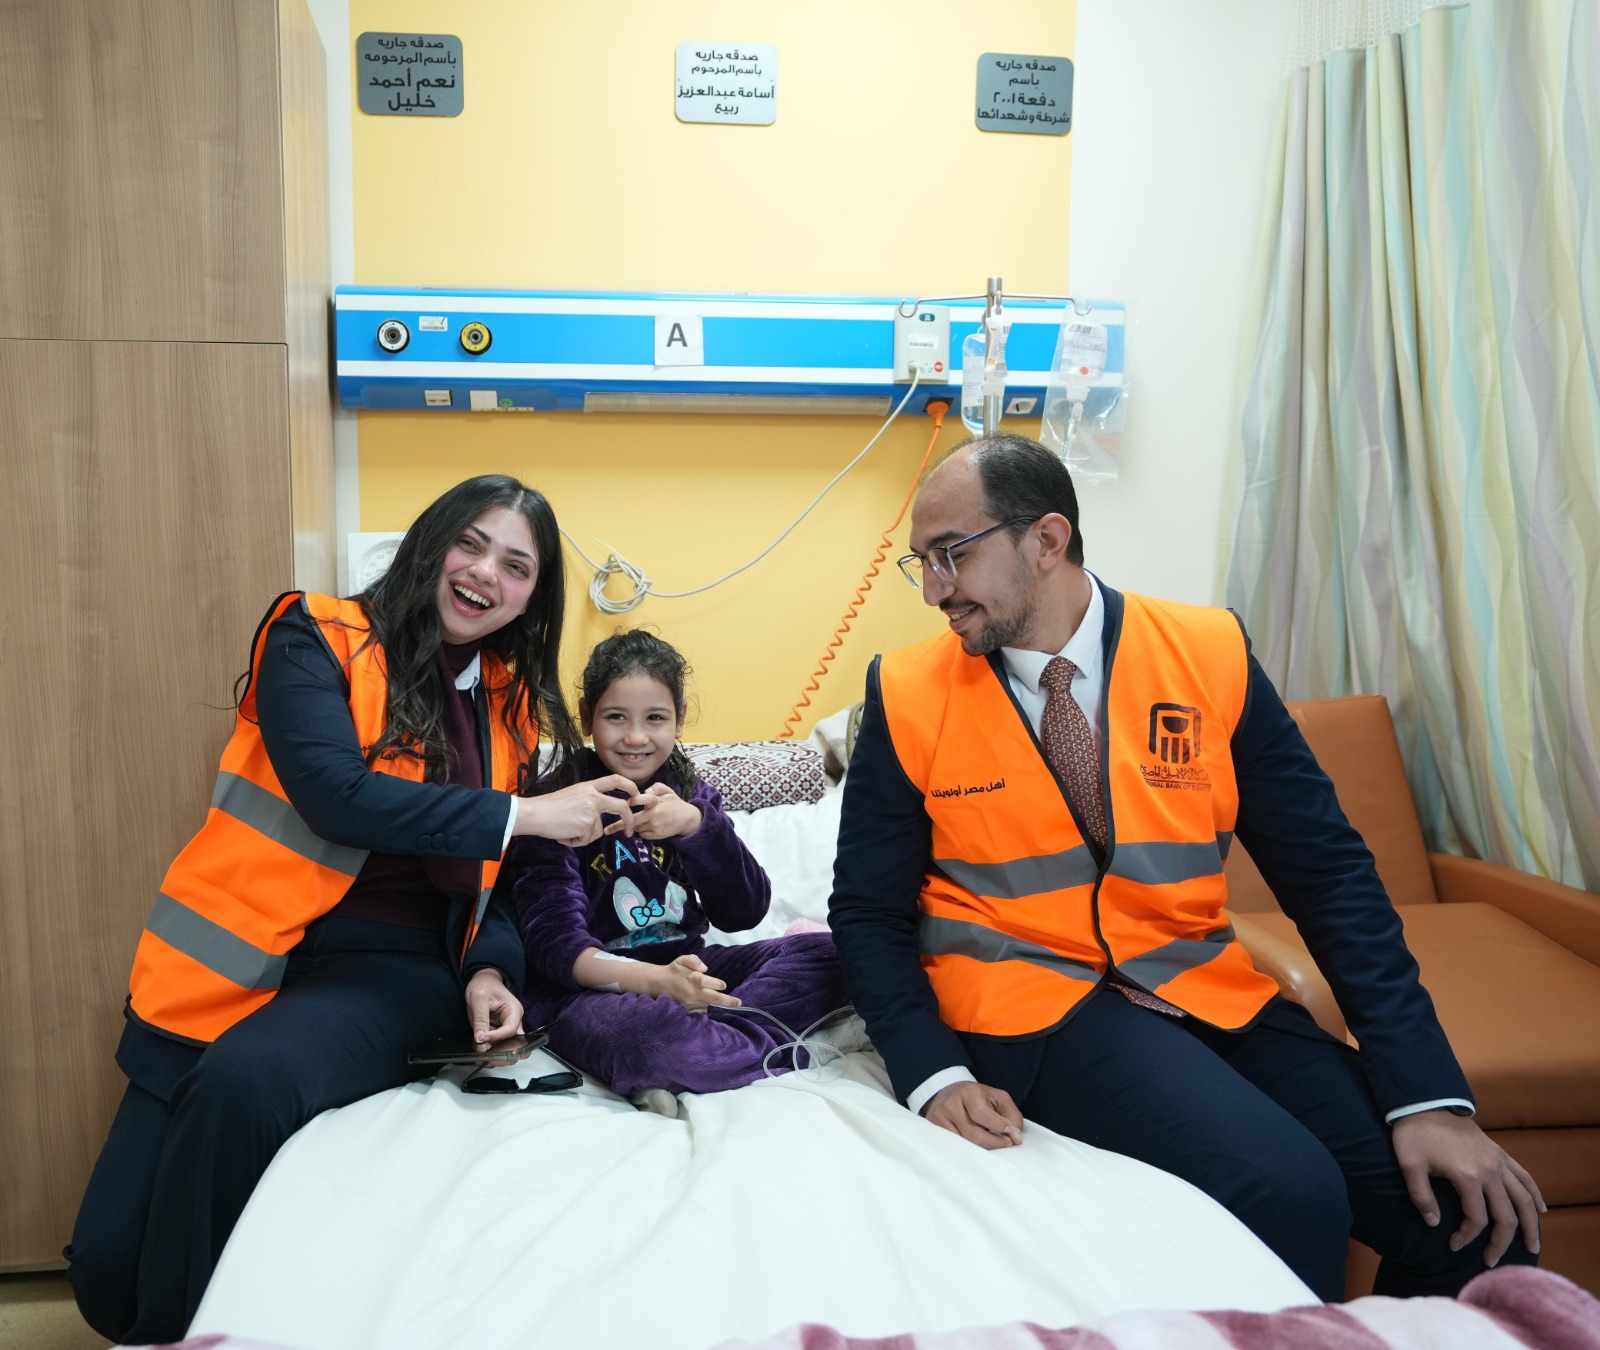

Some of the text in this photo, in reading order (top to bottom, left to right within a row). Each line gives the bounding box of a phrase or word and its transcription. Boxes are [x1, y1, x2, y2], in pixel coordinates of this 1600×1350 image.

[377, 36, 444, 50] صدقه جاريه
[364, 51, 423, 65] المرحومه
[695, 49, 759, 62] صدقه جاريه
[691, 64, 735, 76] المرحوم
[995, 59, 1057, 72] صدقه جاريه
[369, 67, 455, 91] نعم أحمد
[677, 85, 775, 99] أسامة عبدالعزيز
[387, 91, 436, 112] خليل
[1018, 92, 1056, 107] دفعة
[714, 103, 739, 115] ربيع
[1035, 111, 1070, 125] شرطة
[666, 322, 688, 347] A
[930, 777, 1006, 798] أهل مصر أولويتنا
[1165, 782, 1182, 790] BANK
